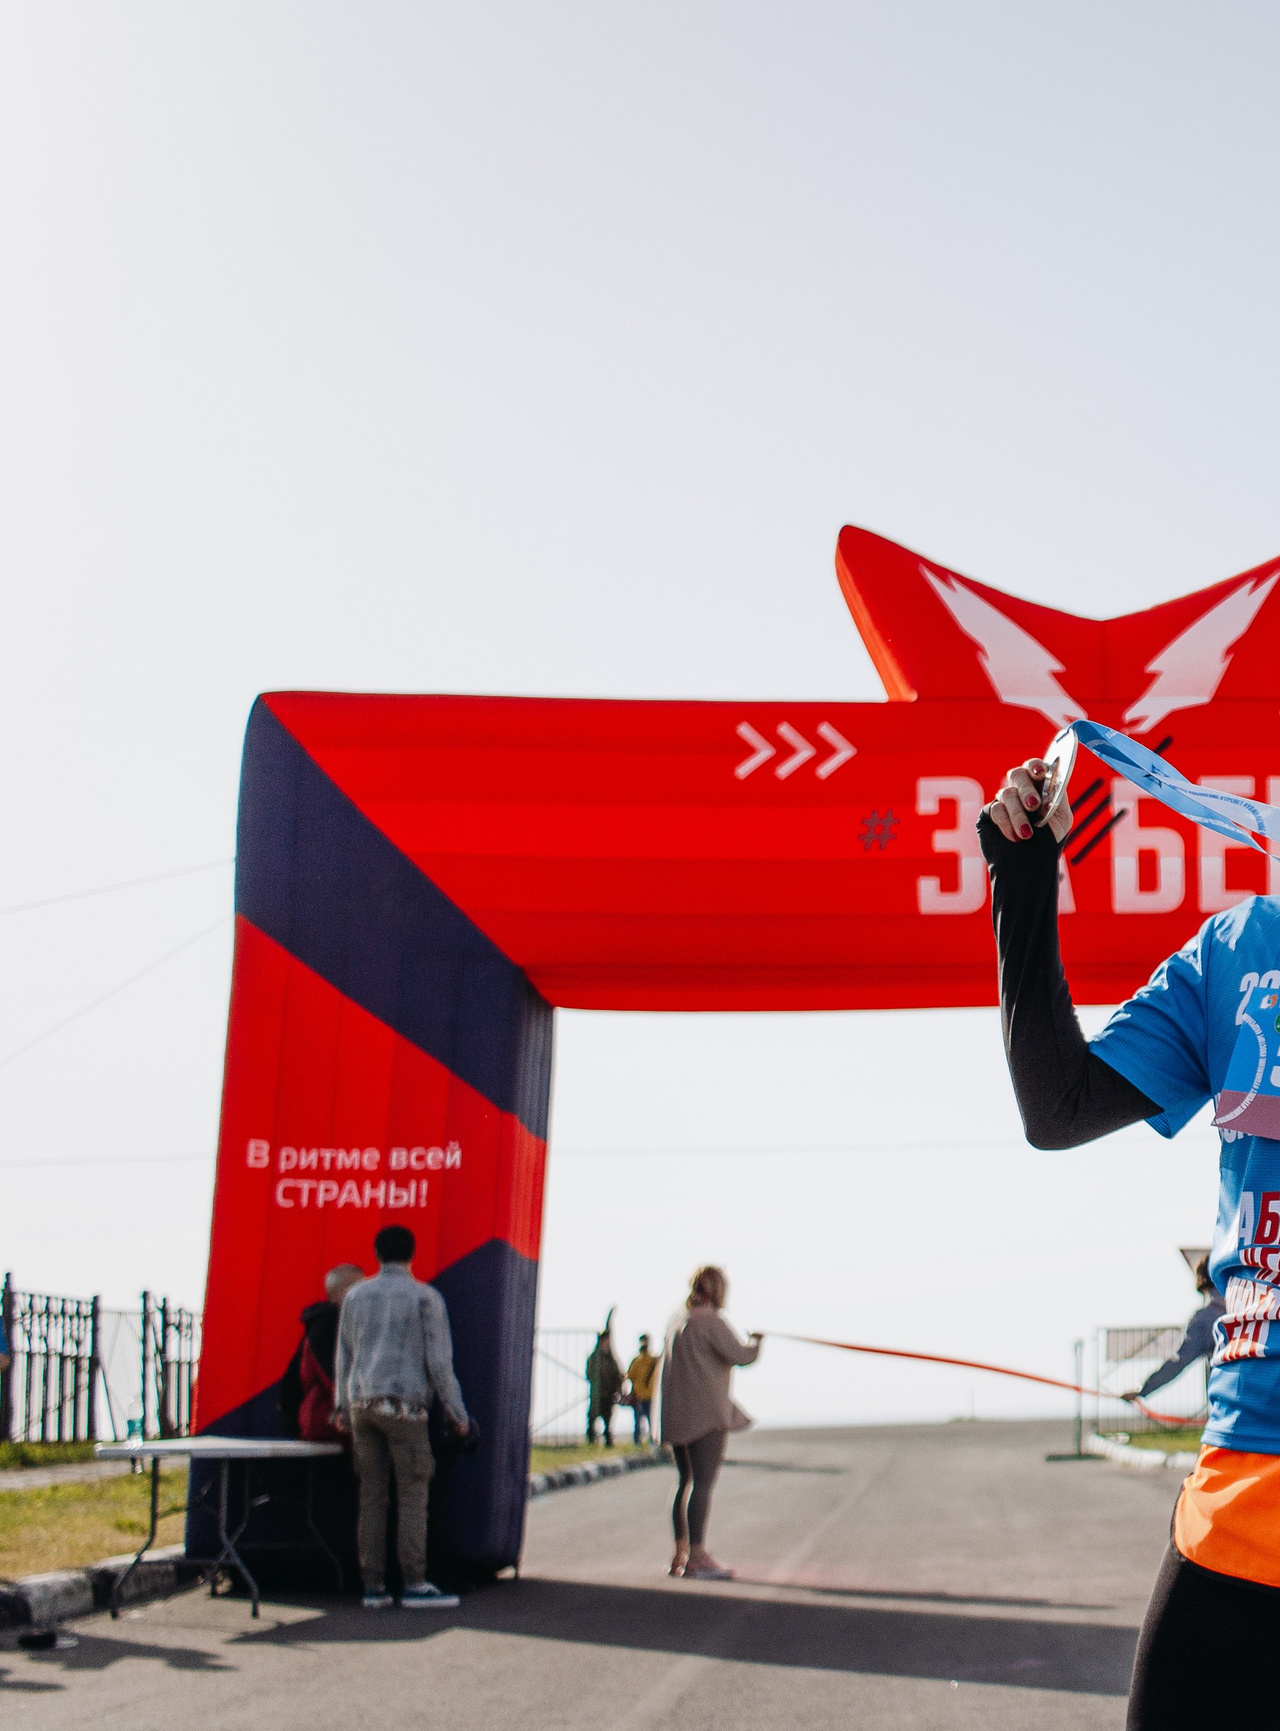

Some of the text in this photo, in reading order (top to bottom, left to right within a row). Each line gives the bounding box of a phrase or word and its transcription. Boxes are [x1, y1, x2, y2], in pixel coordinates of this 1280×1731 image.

[246, 1138, 462, 1173] В ритме всей
[275, 1178, 428, 1208] СТРАНЫ!
